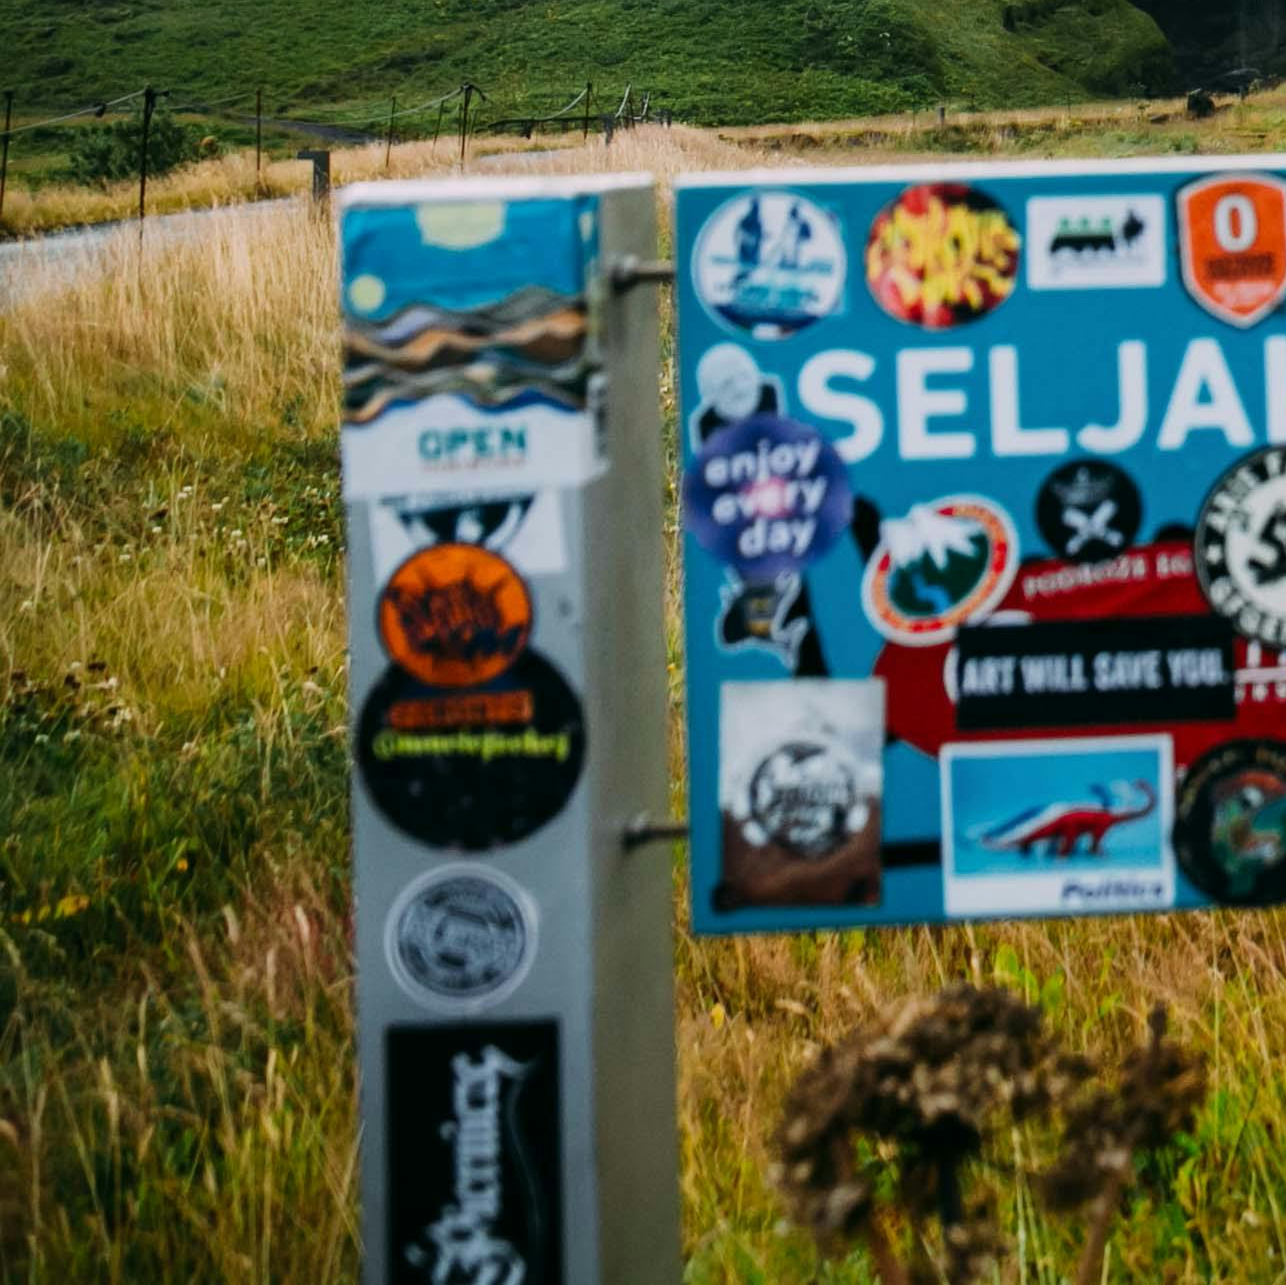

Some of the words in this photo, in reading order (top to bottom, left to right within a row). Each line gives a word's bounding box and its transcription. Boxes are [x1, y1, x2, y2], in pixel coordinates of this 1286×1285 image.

[419, 425, 527, 459] OPEN
[704, 438, 822, 484] enjoy
[712, 476, 827, 525] every
[738, 516, 816, 558] day
[961, 656, 1015, 696] ART
[1020, 653, 1087, 694] WILL
[1094, 650, 1162, 691] SAVE
